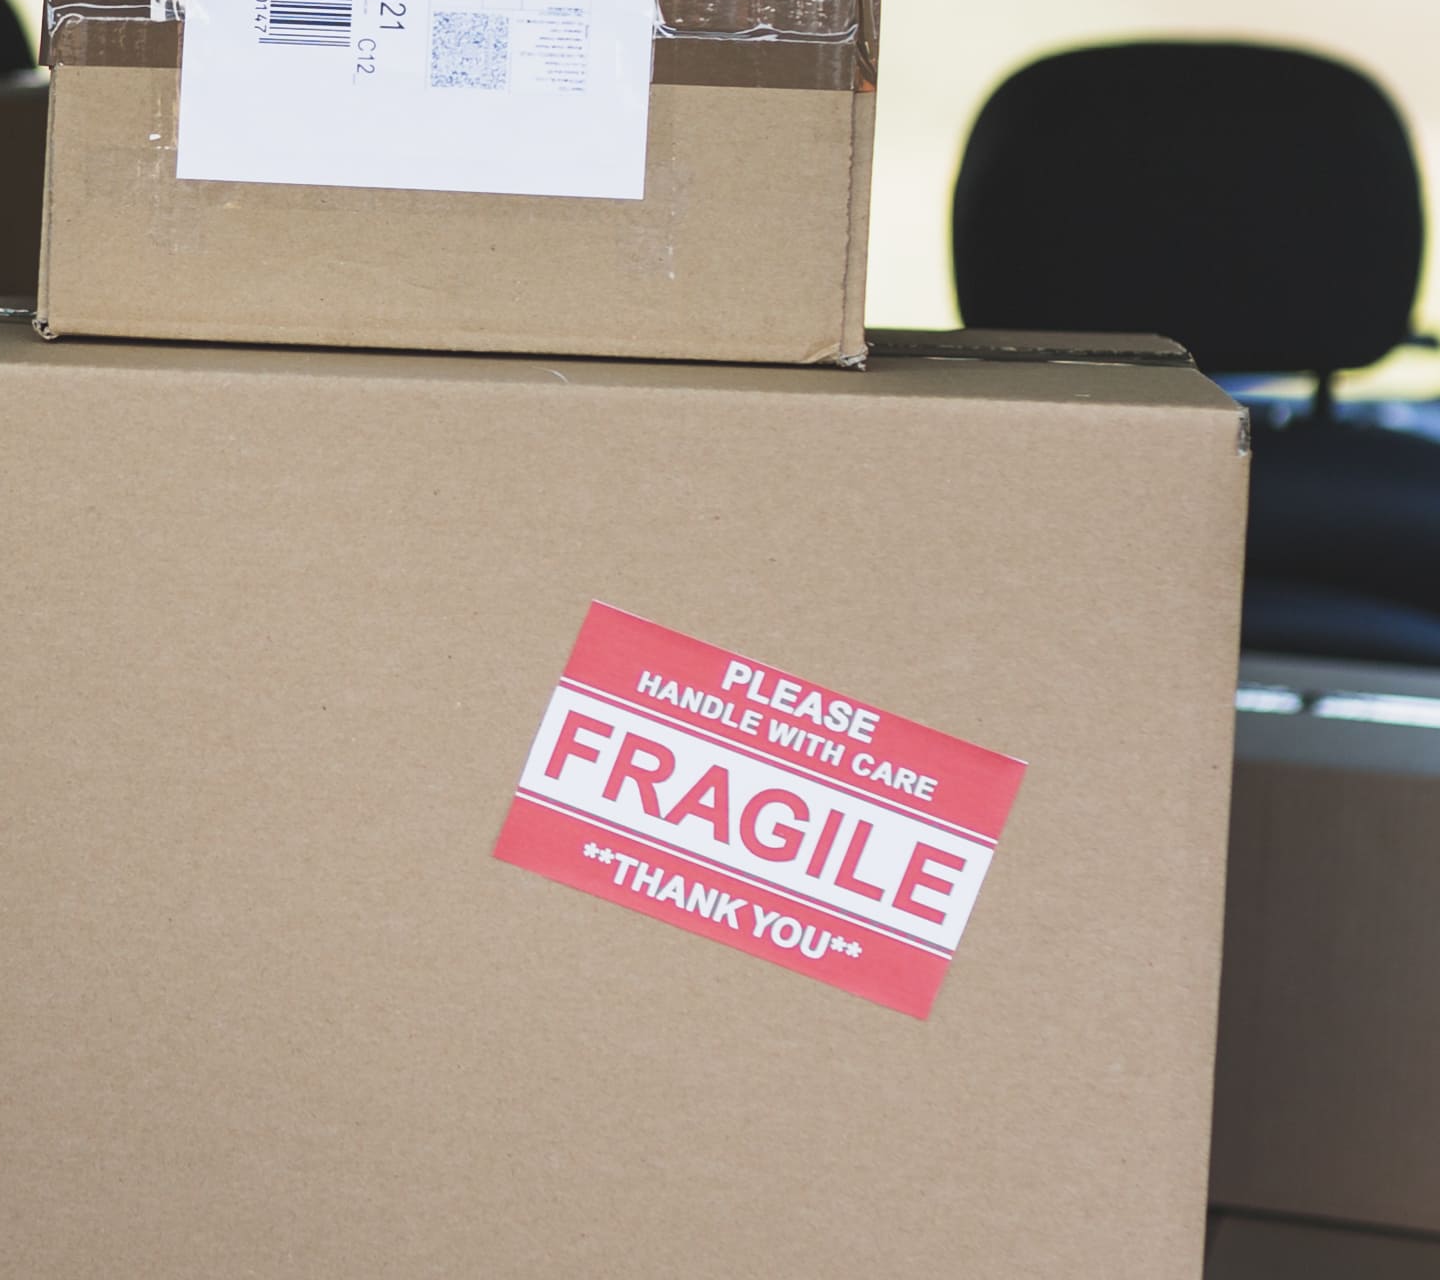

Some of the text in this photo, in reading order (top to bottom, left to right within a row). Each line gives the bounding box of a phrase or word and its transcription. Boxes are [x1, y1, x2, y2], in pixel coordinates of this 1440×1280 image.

[636, 670, 939, 801] HANDLE WITH CARE
[722, 658, 881, 745] PLEASE
[544, 708, 967, 926] FRAGILE
